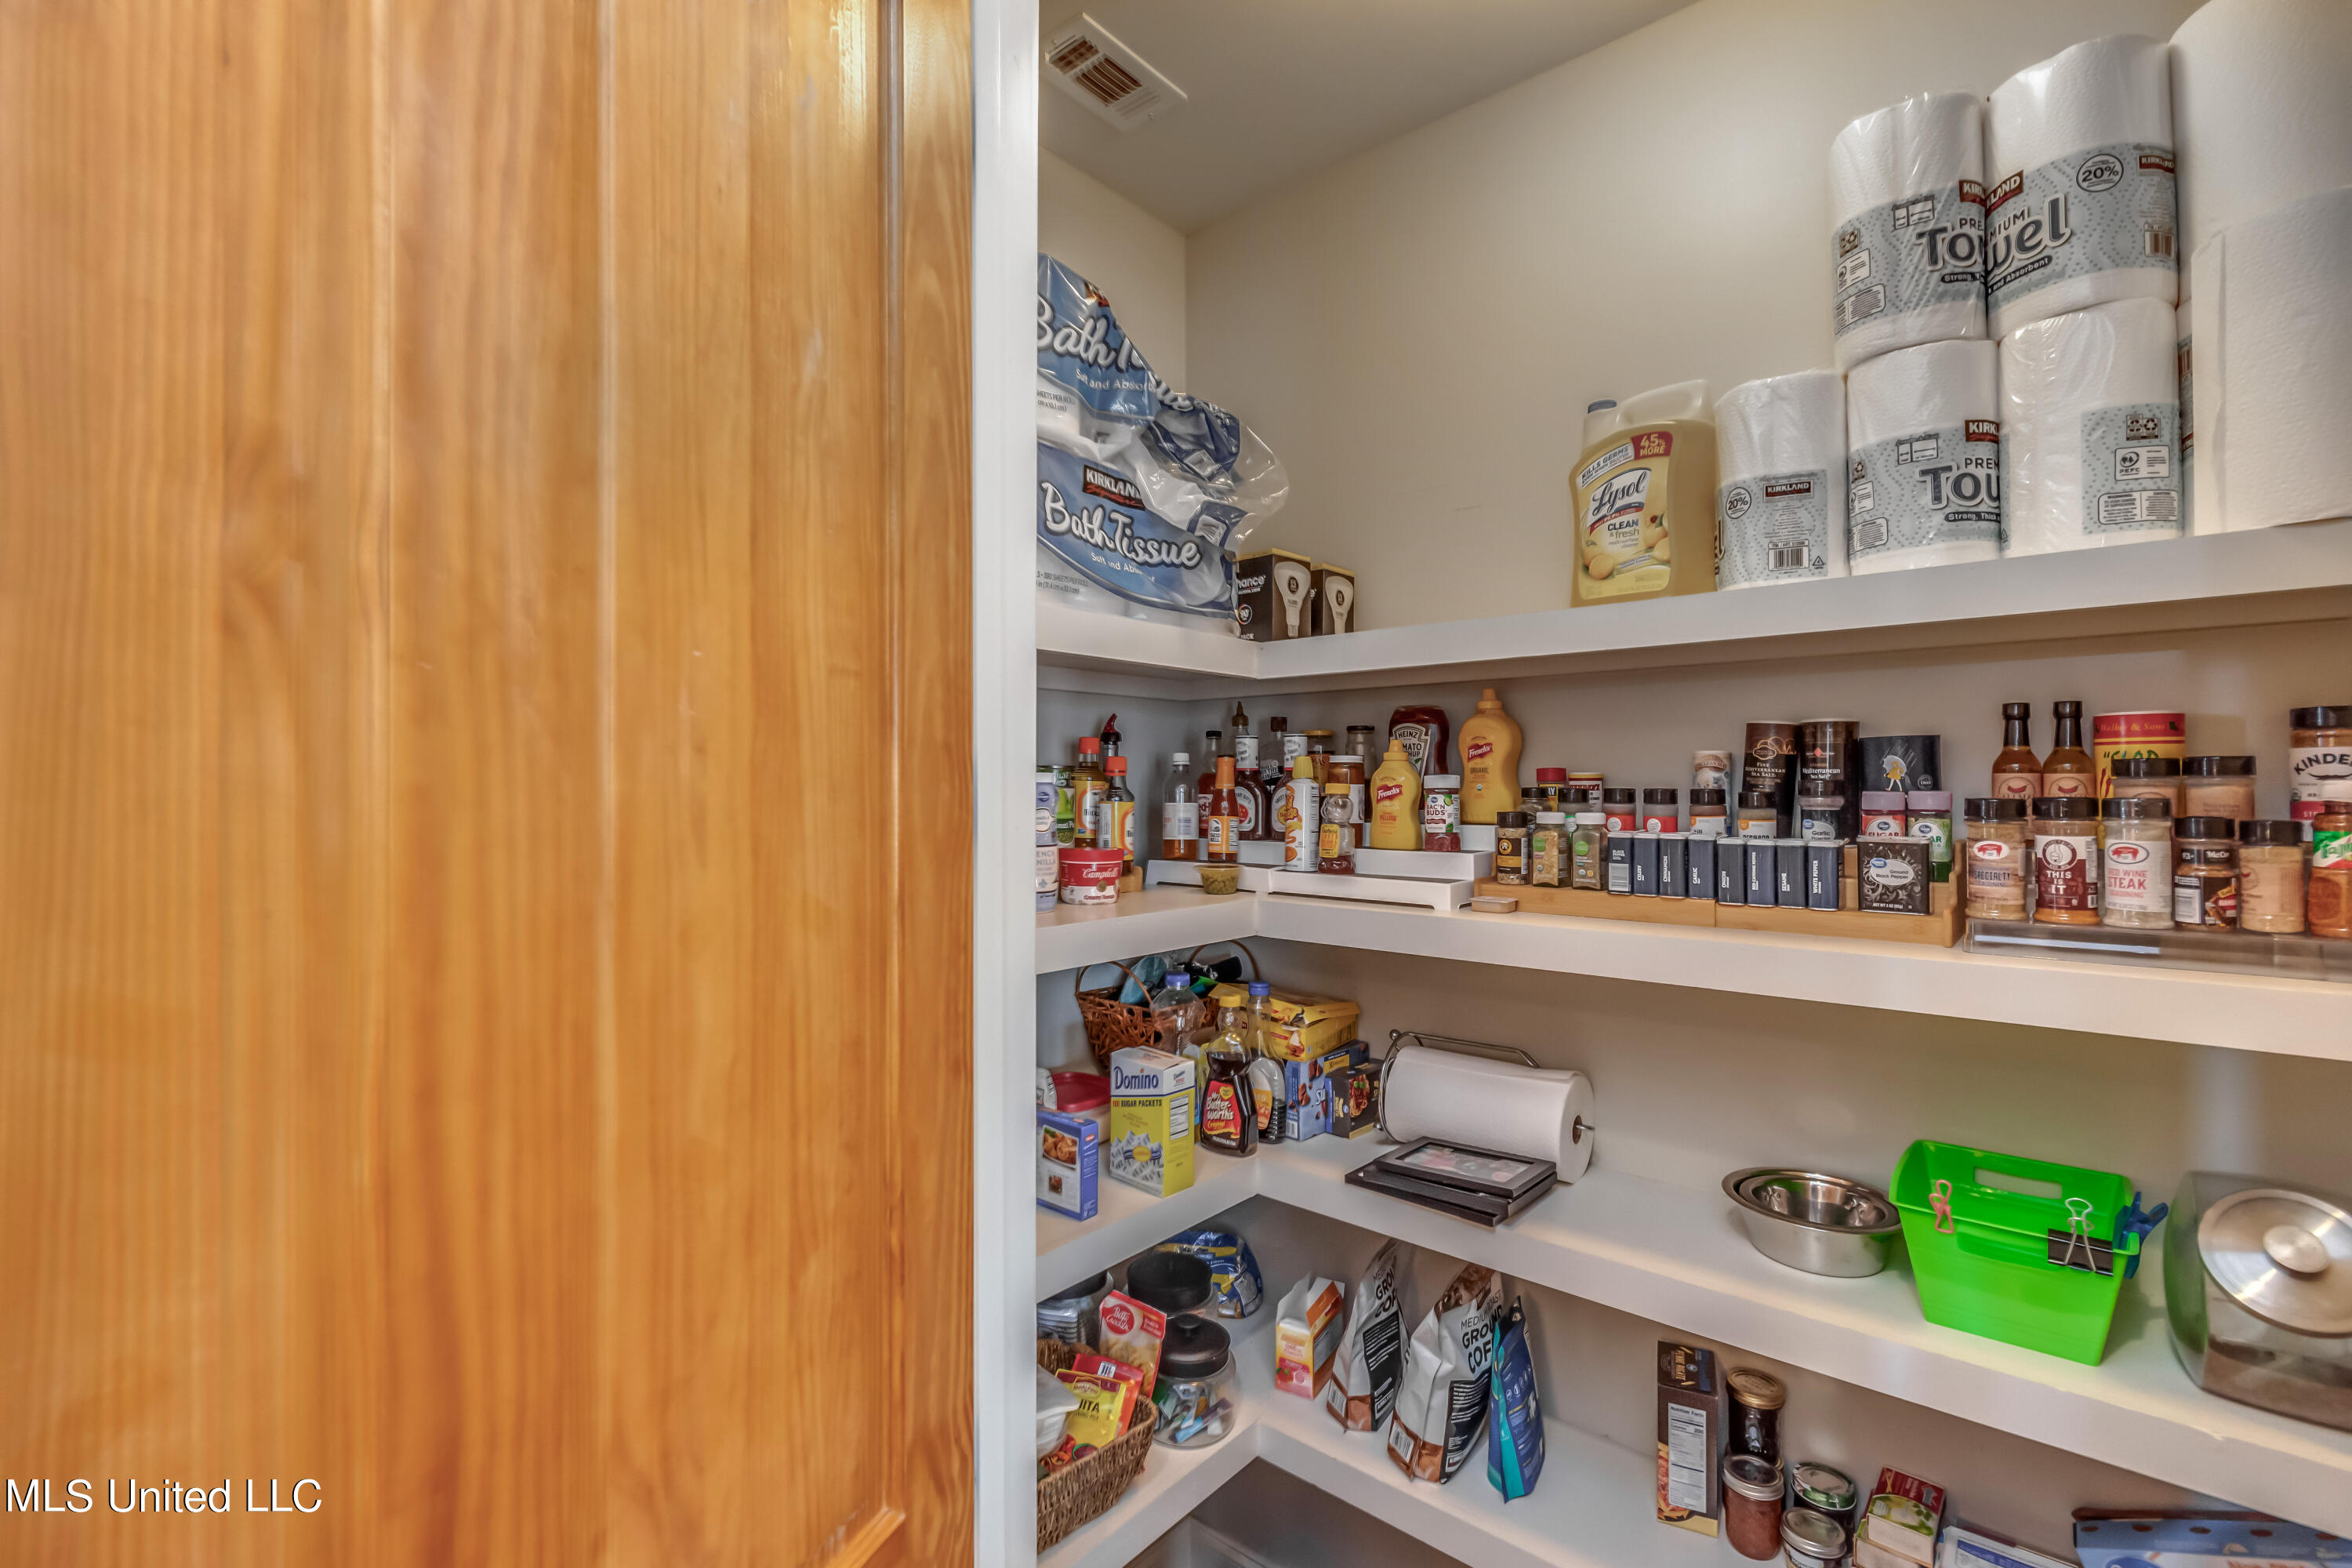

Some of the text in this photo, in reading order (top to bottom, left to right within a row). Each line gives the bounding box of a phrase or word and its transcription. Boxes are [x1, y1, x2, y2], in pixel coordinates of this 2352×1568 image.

[2141, 156, 2174, 168] KIRKLAND
[2082, 166, 2119, 183] 20%
[2006, 258, 2049, 281] Absorbent
[1089, 379, 1109, 390] and
[1640, 446, 1665, 456] MORE
[1582, 445, 1629, 479] KILLS GERMS
[1592, 470, 1647, 517] Lysol
[1767, 482, 1809, 493] KIRKLAND
[1728, 495, 1749, 510] 20%
[1040, 481, 1201, 568] Bath Tissue
[1607, 518, 1639, 532] CLEAN
[1615, 528, 1640, 539] fresh
[2131, 723, 2140, 731] &
[1398, 730, 1418, 739] HEINZ
[1468, 745, 1492, 758] French's
[1377, 787, 1401, 800] French's
[1974, 871, 2010, 881] SPECIALTY
[2045, 870, 2072, 879] THIS
[2122, 869, 2147, 878] WINE
[2051, 884, 2067, 895] IT
[2107, 876, 2147, 891] STEAK
[1114, 1066, 1159, 1090] Domino
[1207, 1097, 1232, 1110] Butter-
